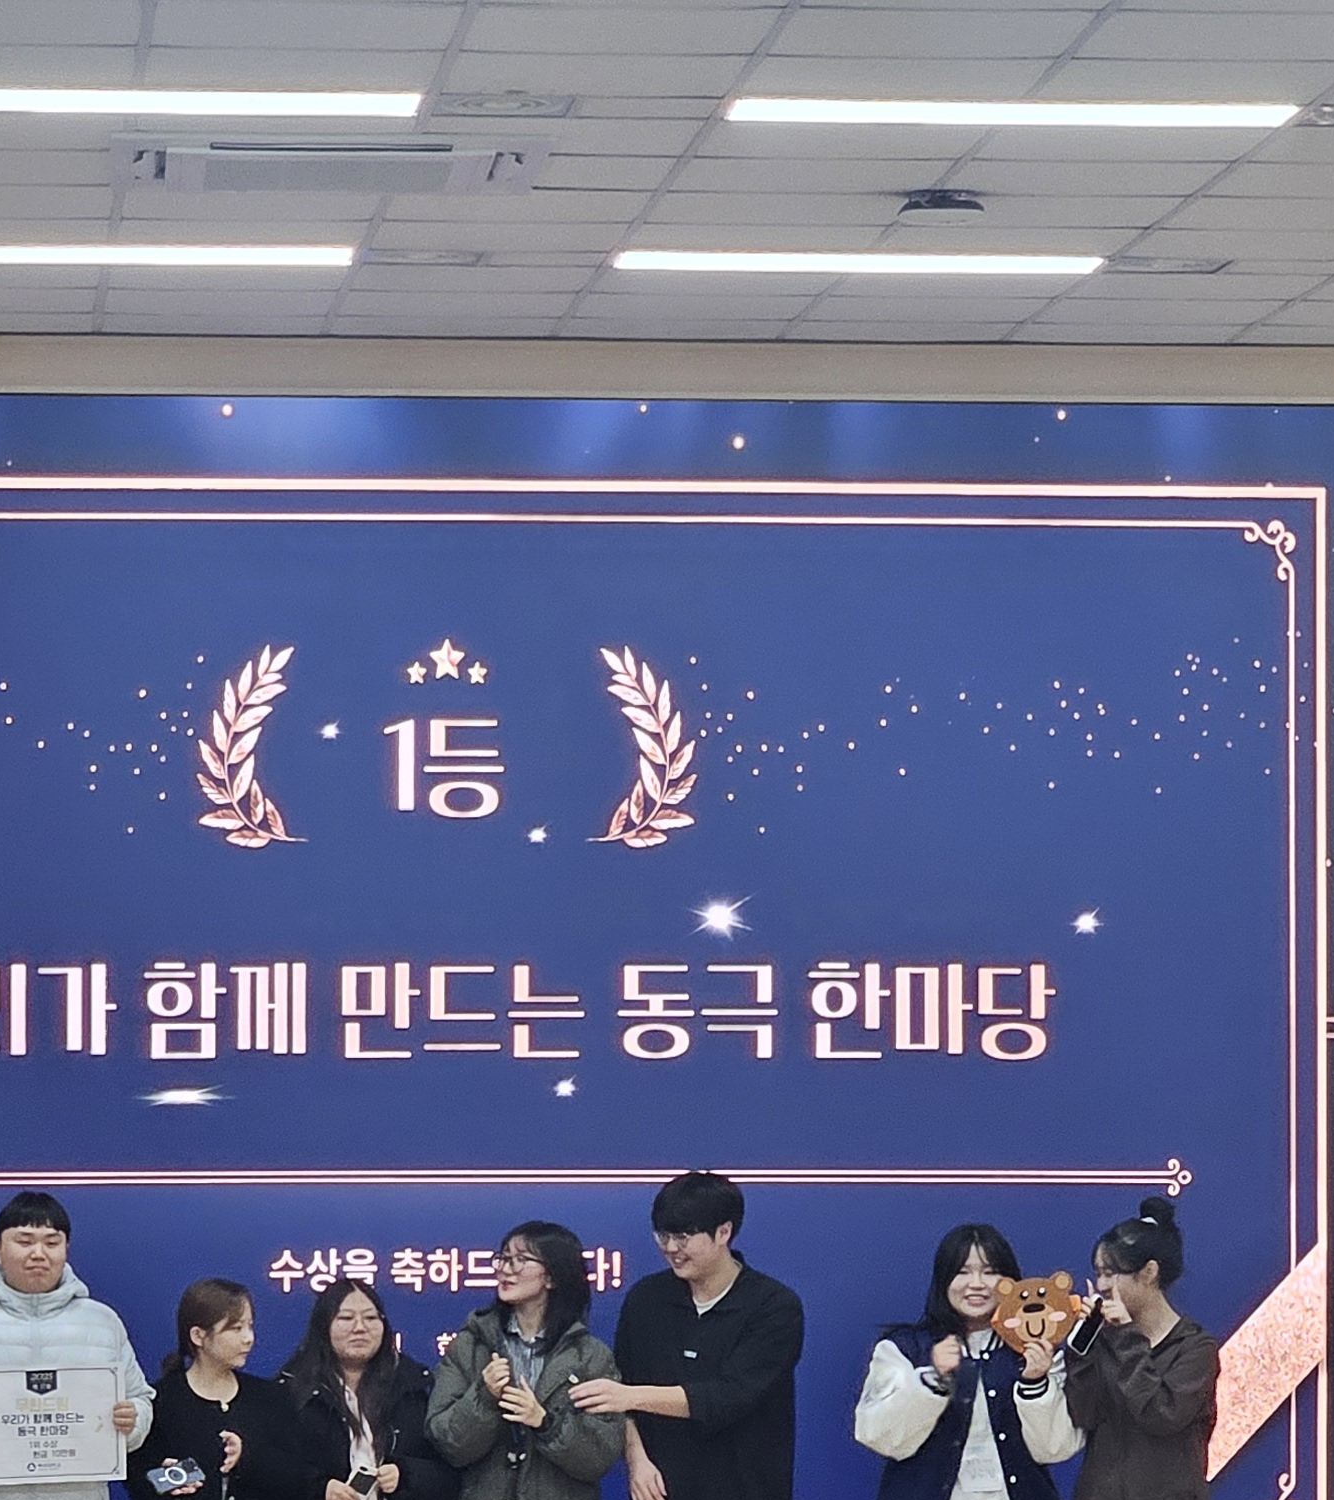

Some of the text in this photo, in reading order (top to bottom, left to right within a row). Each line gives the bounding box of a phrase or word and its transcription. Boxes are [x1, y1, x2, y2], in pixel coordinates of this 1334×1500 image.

[383, 718, 505, 818] 1등
[143, 962, 307, 1060] 함께
[341, 962, 585, 1059] 만드는
[616, 964, 779, 1059] 동극
[807, 961, 1056, 1061] 한마당
[269, 1247, 623, 1294] 수상을 축하드다!
[0, 1413, 31, 1425] 우리가
[55, 1411, 85, 1424] 만드는
[40, 1425, 69, 1437] 한마당
